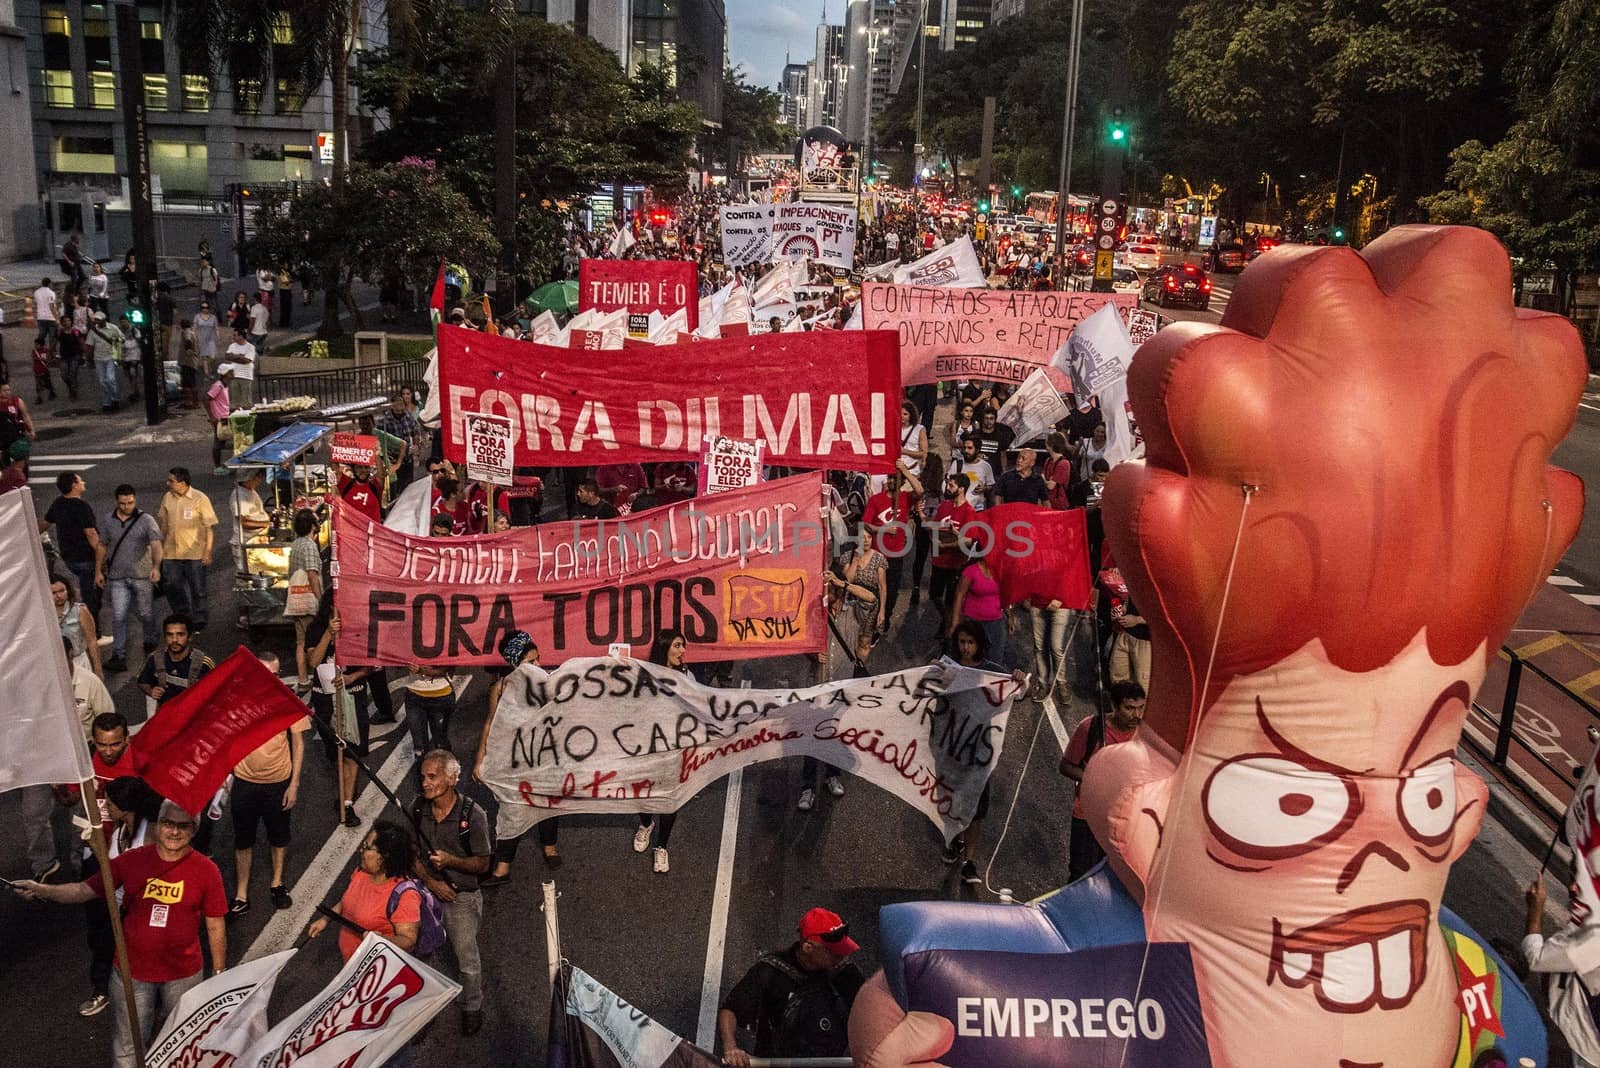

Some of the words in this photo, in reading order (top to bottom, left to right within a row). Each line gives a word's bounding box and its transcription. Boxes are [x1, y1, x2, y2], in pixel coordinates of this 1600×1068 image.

[725, 211, 763, 220] CONTRA
[780, 207, 849, 224] IMPEACHMENT
[1103, 219, 1113, 228] 50
[772, 222, 802, 233] ATAQUES
[816, 219, 844, 231] GOVERNO
[822, 228, 843, 244] PT
[590, 280, 650, 305] TEMER
[658, 279, 668, 305] É
[675, 283, 686, 306] O
[871, 287, 953, 315] CONTRA
[962, 291, 992, 317] OS
[1004, 293, 1098, 321] ATAQUES
[631, 316, 647, 324] FORA
[449, 384, 620, 453] FORA
[637, 393, 886, 457] DILMA!
[333, 446, 360, 455] TEMER
[471, 433, 506, 451] FORA
[472, 445, 506, 459] TODOS
[714, 454, 752, 469] FORA
[714, 466, 752, 477] TODOS
[733, 584, 800, 614] PSTU
[367, 590, 518, 659] FORA
[543, 577, 719, 652] TODOS
[731, 618, 758, 641] DA
[760, 616, 801, 640] SUL
[511, 716, 599, 768] NÃO
[812, 716, 964, 822] Socialista
[147, 883, 180, 899] PSTU
[186, 993, 235, 1029] SINDICAL
[1461, 981, 1493, 1029] PT
[957, 996, 1167, 1041] EMPREGO
[179, 1028, 186, 1038] E
